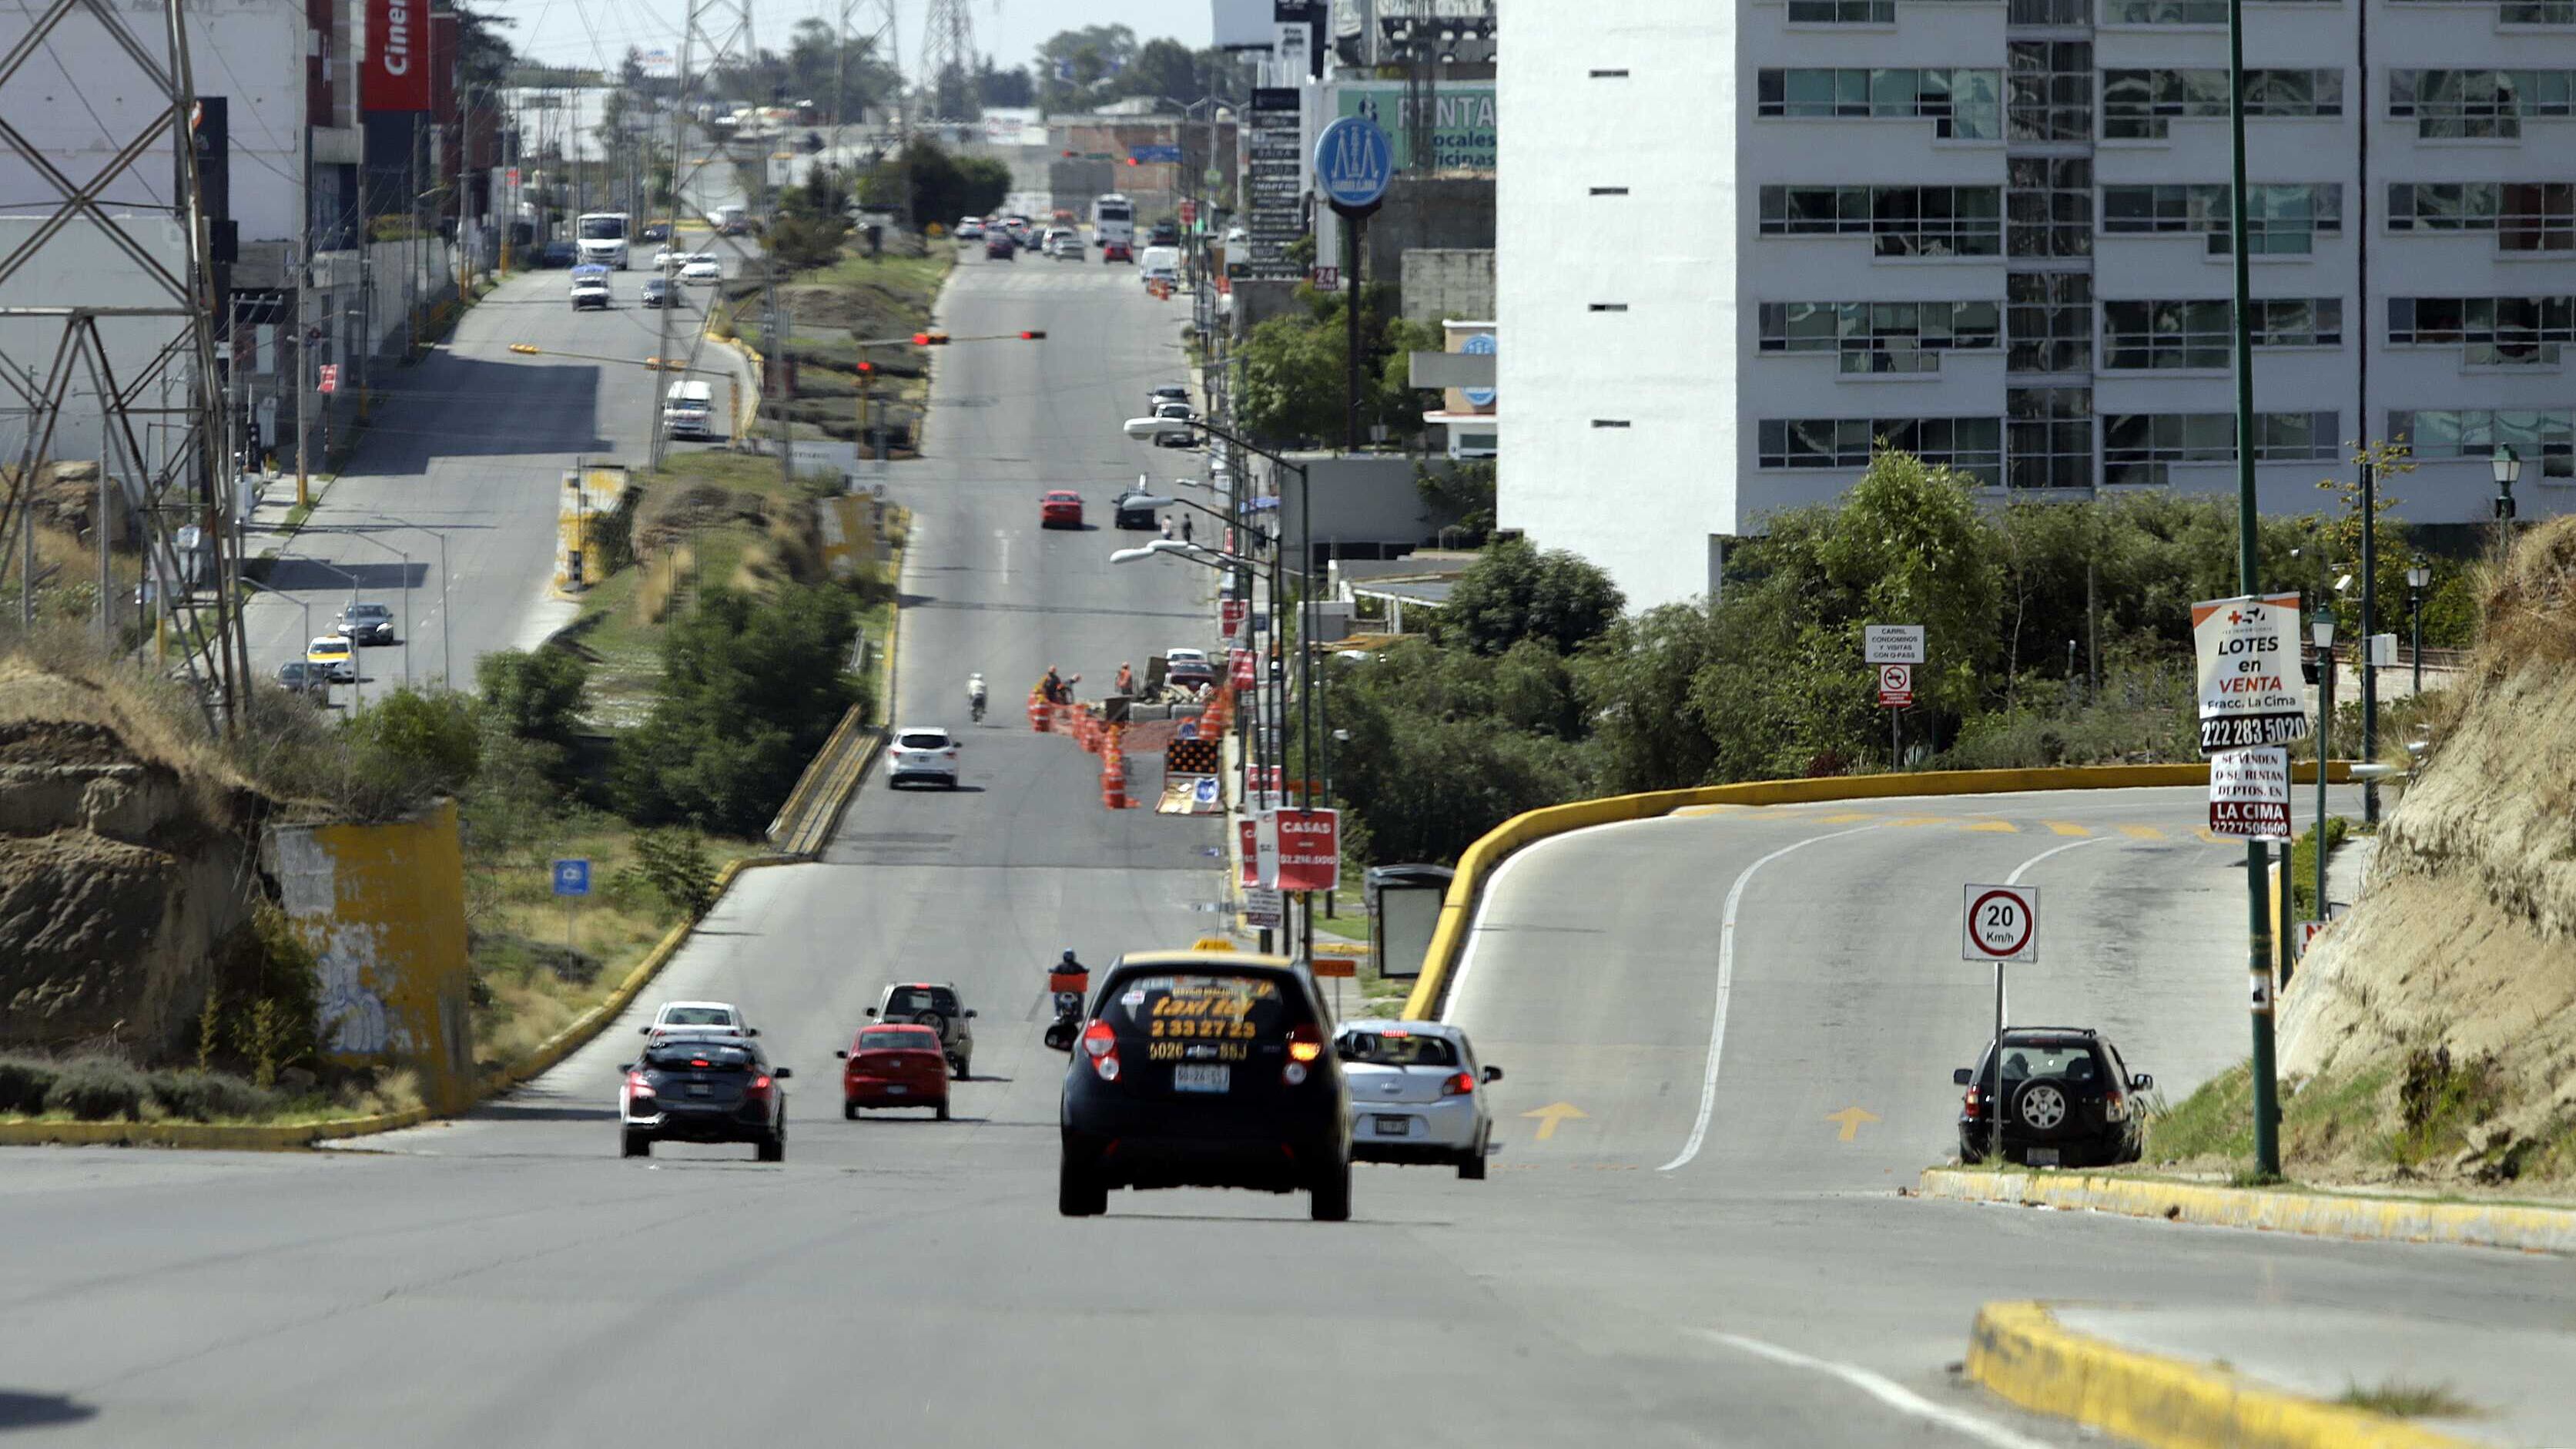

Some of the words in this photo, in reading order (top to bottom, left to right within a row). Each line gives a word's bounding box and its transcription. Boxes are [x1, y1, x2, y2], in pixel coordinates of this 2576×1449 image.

[1432, 131, 1496, 148] ocales
[2218, 636, 2279, 656] LOTES
[2238, 659, 2262, 673] en
[2219, 676, 2283, 694] VENTA
[2207, 699, 2245, 710] Fracc.
[2248, 697, 2262, 707] La
[2264, 694, 2296, 707] Cima
[2201, 719, 2231, 747] 222
[2233, 718, 2263, 746] 283
[2264, 716, 2306, 744] 5020
[2223, 754, 2235, 763] SE
[2239, 753, 2279, 765] VENDEN
[2216, 770, 2223, 780] O
[2245, 770, 2283, 781] RENTAN
[2218, 786, 2266, 797] DEPTOS.
[2269, 786, 2283, 797] EN
[2217, 803, 2239, 820] LA
[2242, 803, 2285, 820] CIMA
[1281, 821, 1332, 834] CASAS
[1987, 905, 2014, 927] 20
[1986, 931, 2014, 944] Km/h
[1152, 1020, 1164, 1037] 2
[1149, 1042, 1184, 1060] 5026
